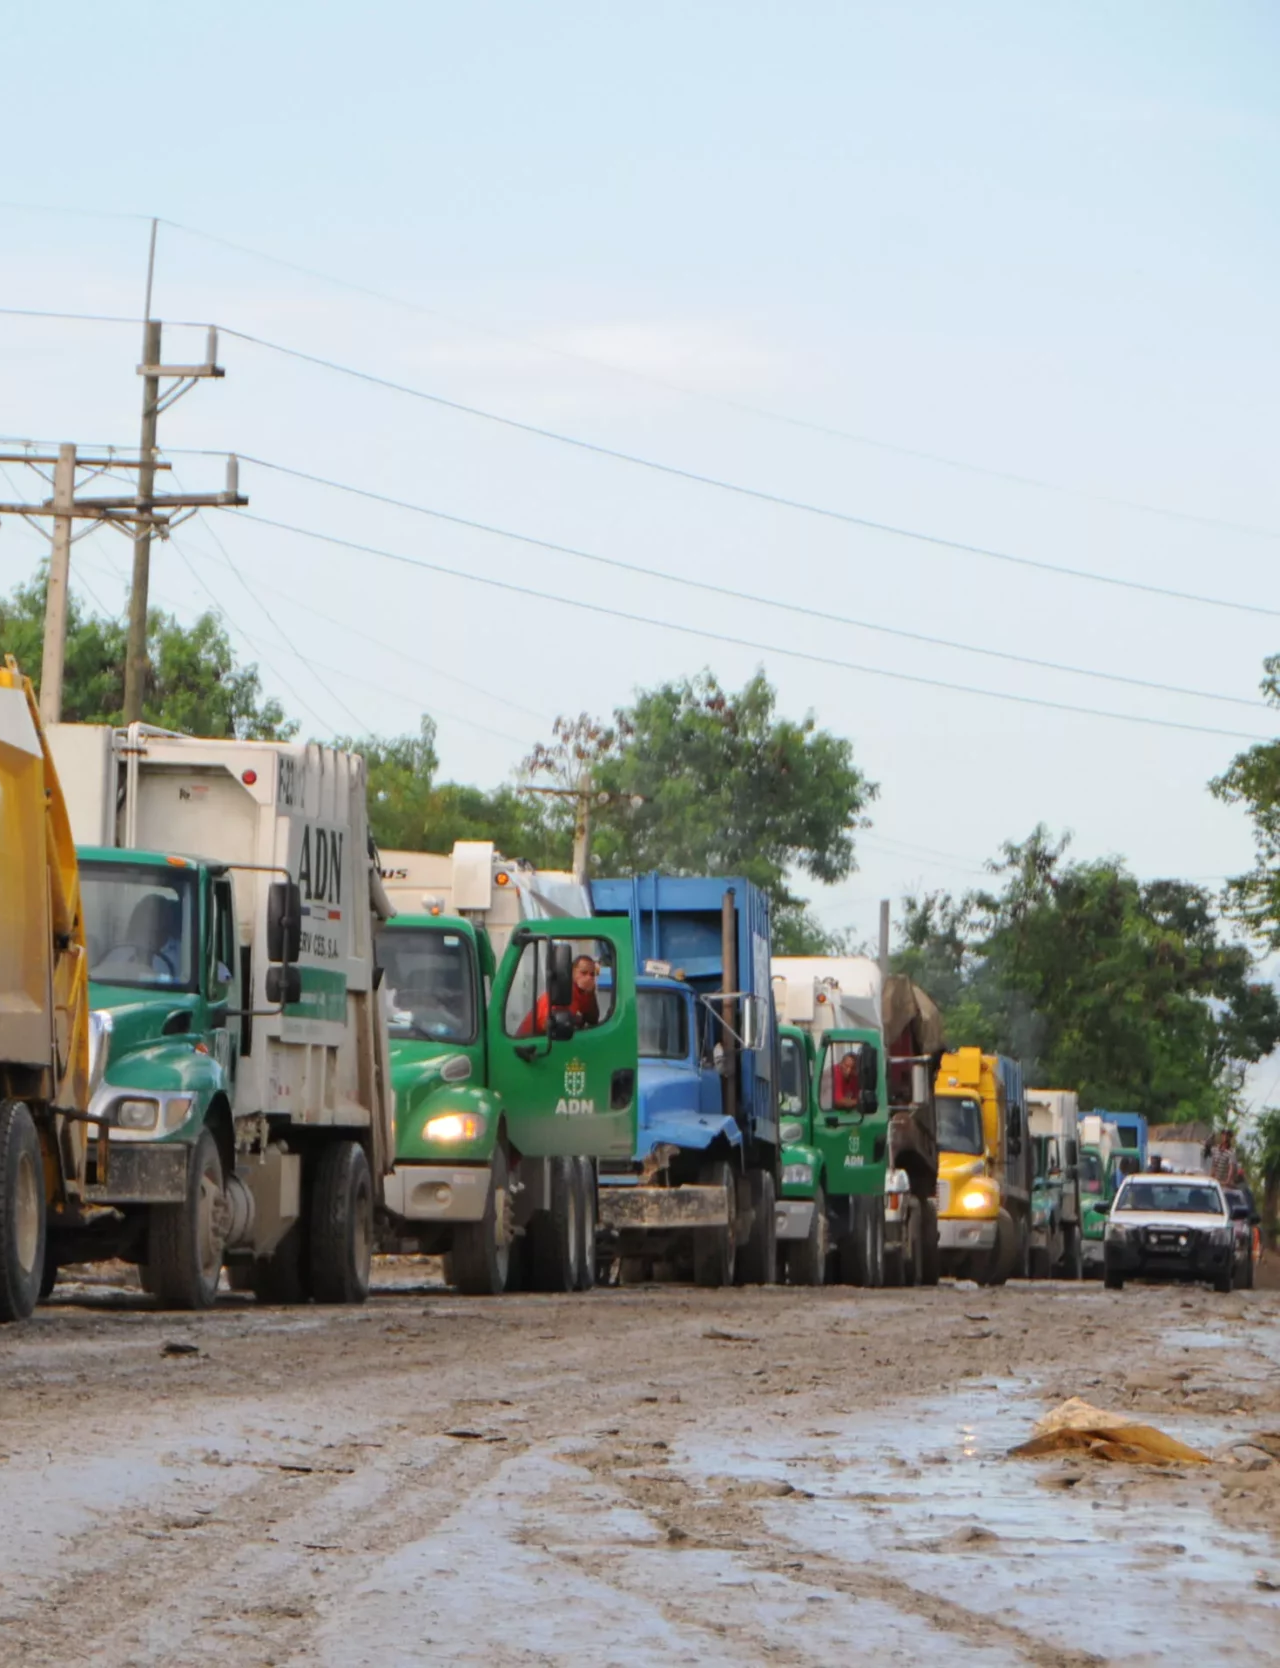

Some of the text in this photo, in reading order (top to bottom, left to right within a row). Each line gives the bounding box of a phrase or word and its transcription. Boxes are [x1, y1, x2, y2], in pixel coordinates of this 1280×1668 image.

[297, 823, 344, 905] ADN
[555, 1098, 595, 1115] ADN
[843, 1155, 864, 1168] ADN
